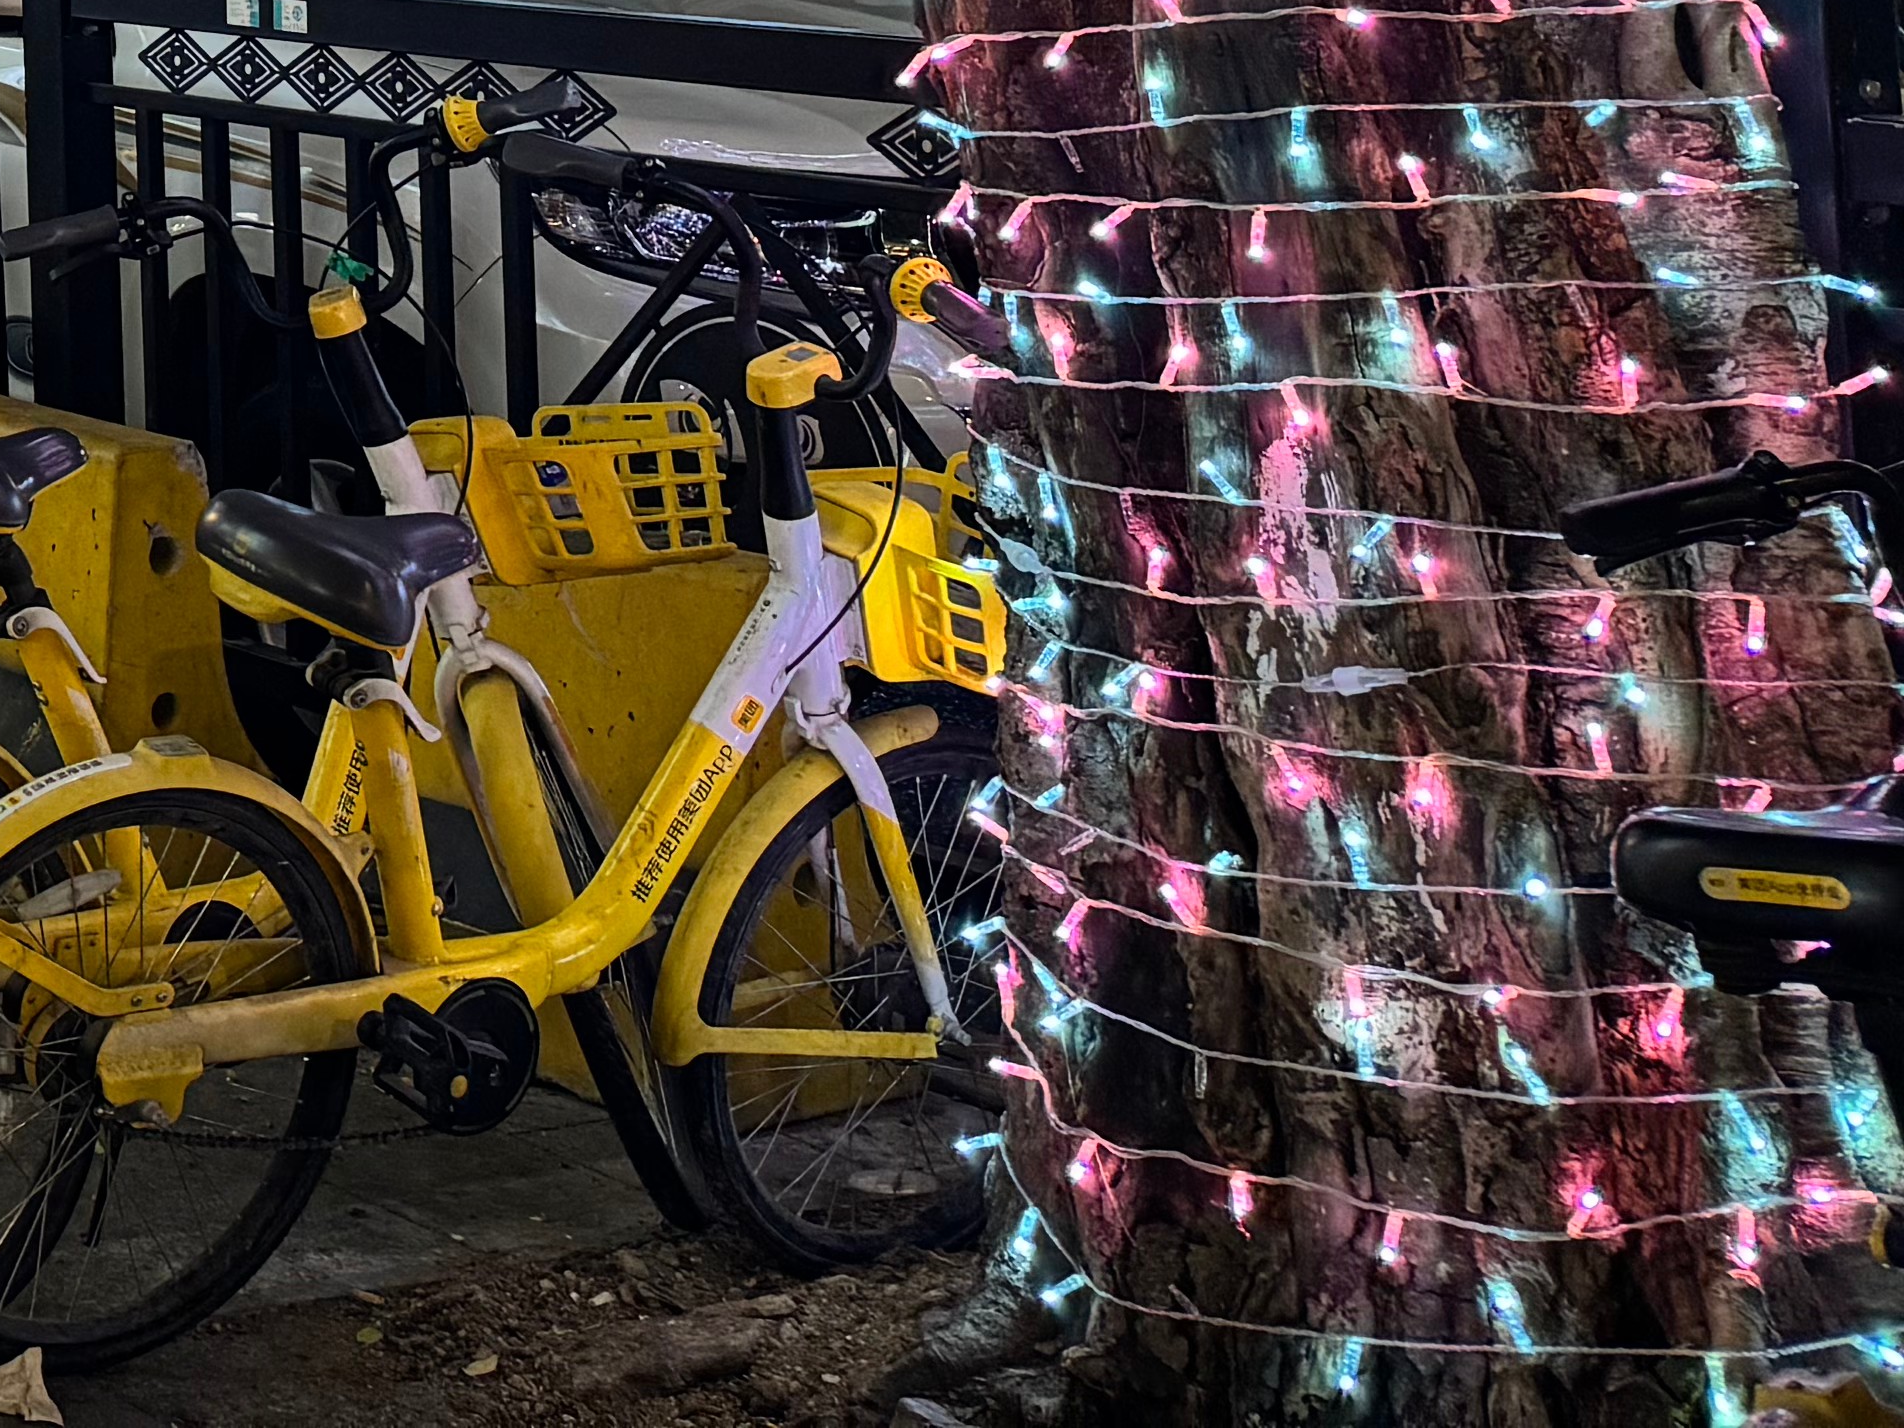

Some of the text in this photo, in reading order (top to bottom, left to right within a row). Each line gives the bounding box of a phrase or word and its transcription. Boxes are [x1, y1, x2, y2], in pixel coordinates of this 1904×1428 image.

[629, 743, 736, 904] 推荐使用美团App
